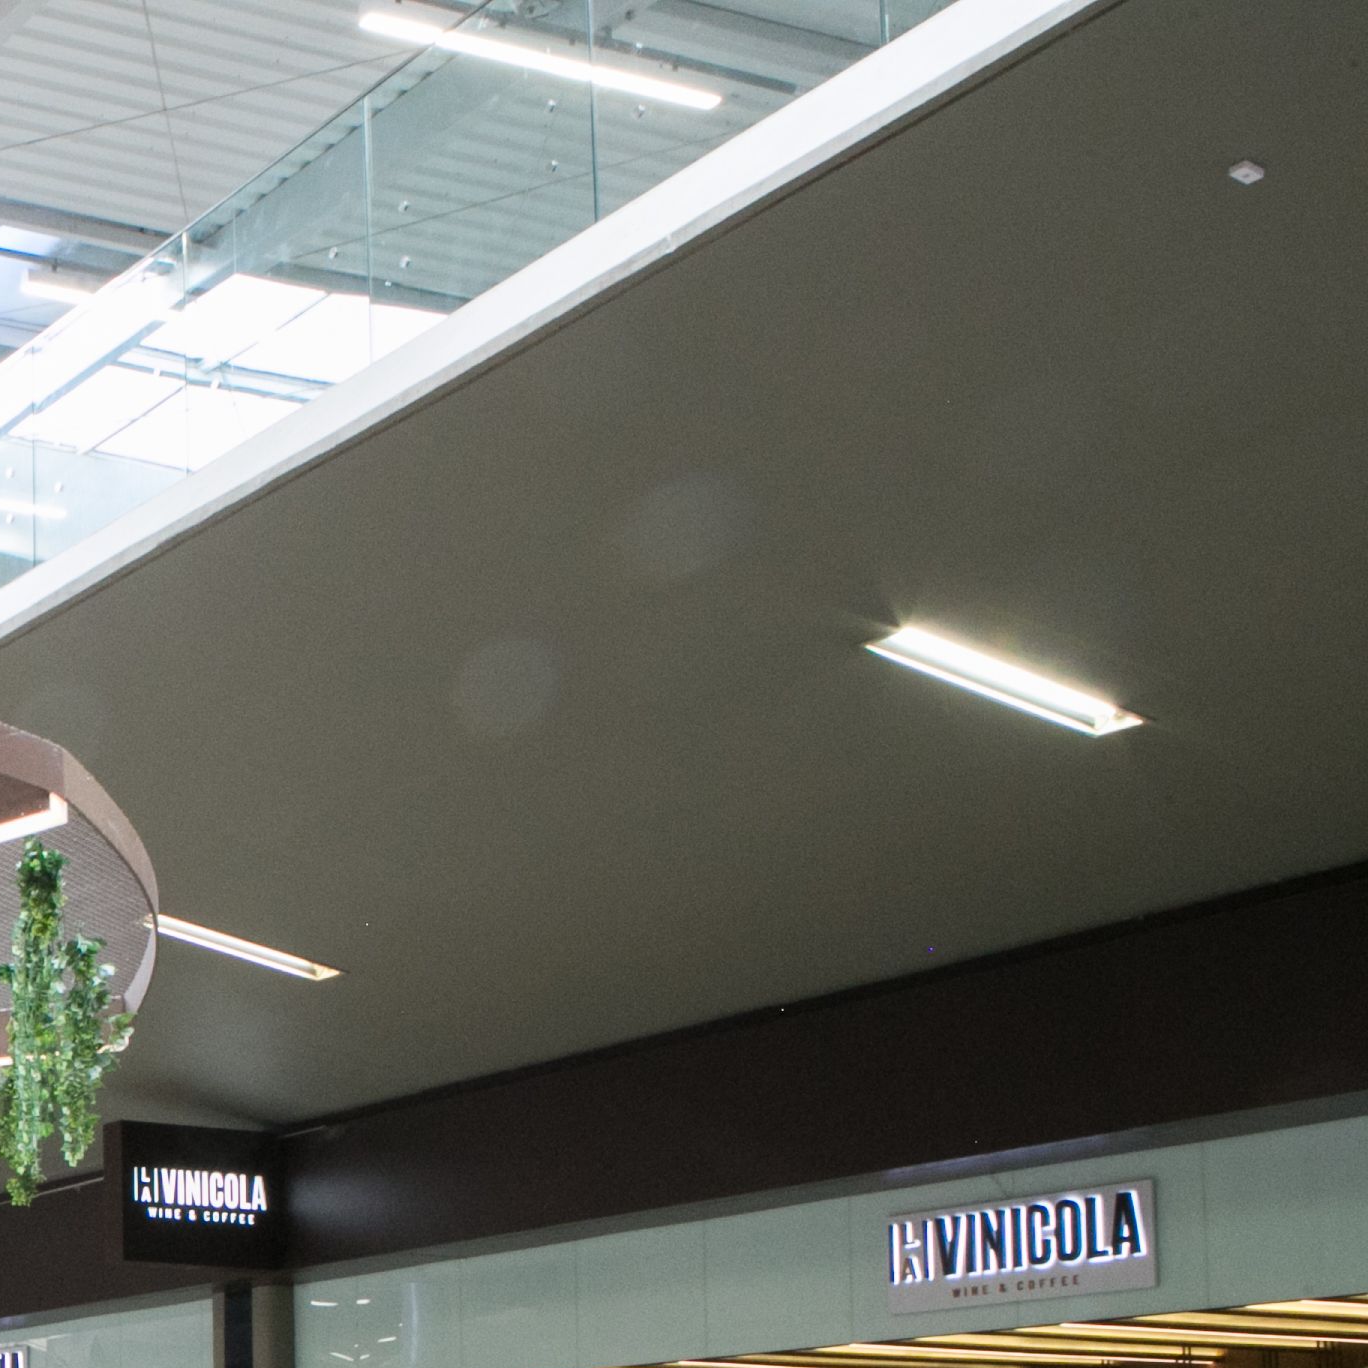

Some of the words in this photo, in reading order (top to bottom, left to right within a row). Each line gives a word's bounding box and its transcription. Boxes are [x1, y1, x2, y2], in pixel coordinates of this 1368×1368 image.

[160, 1167, 268, 1211] VINICOLA
[147, 1206, 182, 1220] WINE
[203, 1210, 255, 1226] COFFEE
[935, 1190, 1144, 1279] VINICOLA
[952, 1284, 989, 1299] WINE
[999, 1283, 1007, 1293] &
[1016, 1274, 1081, 1292] COFFEE
